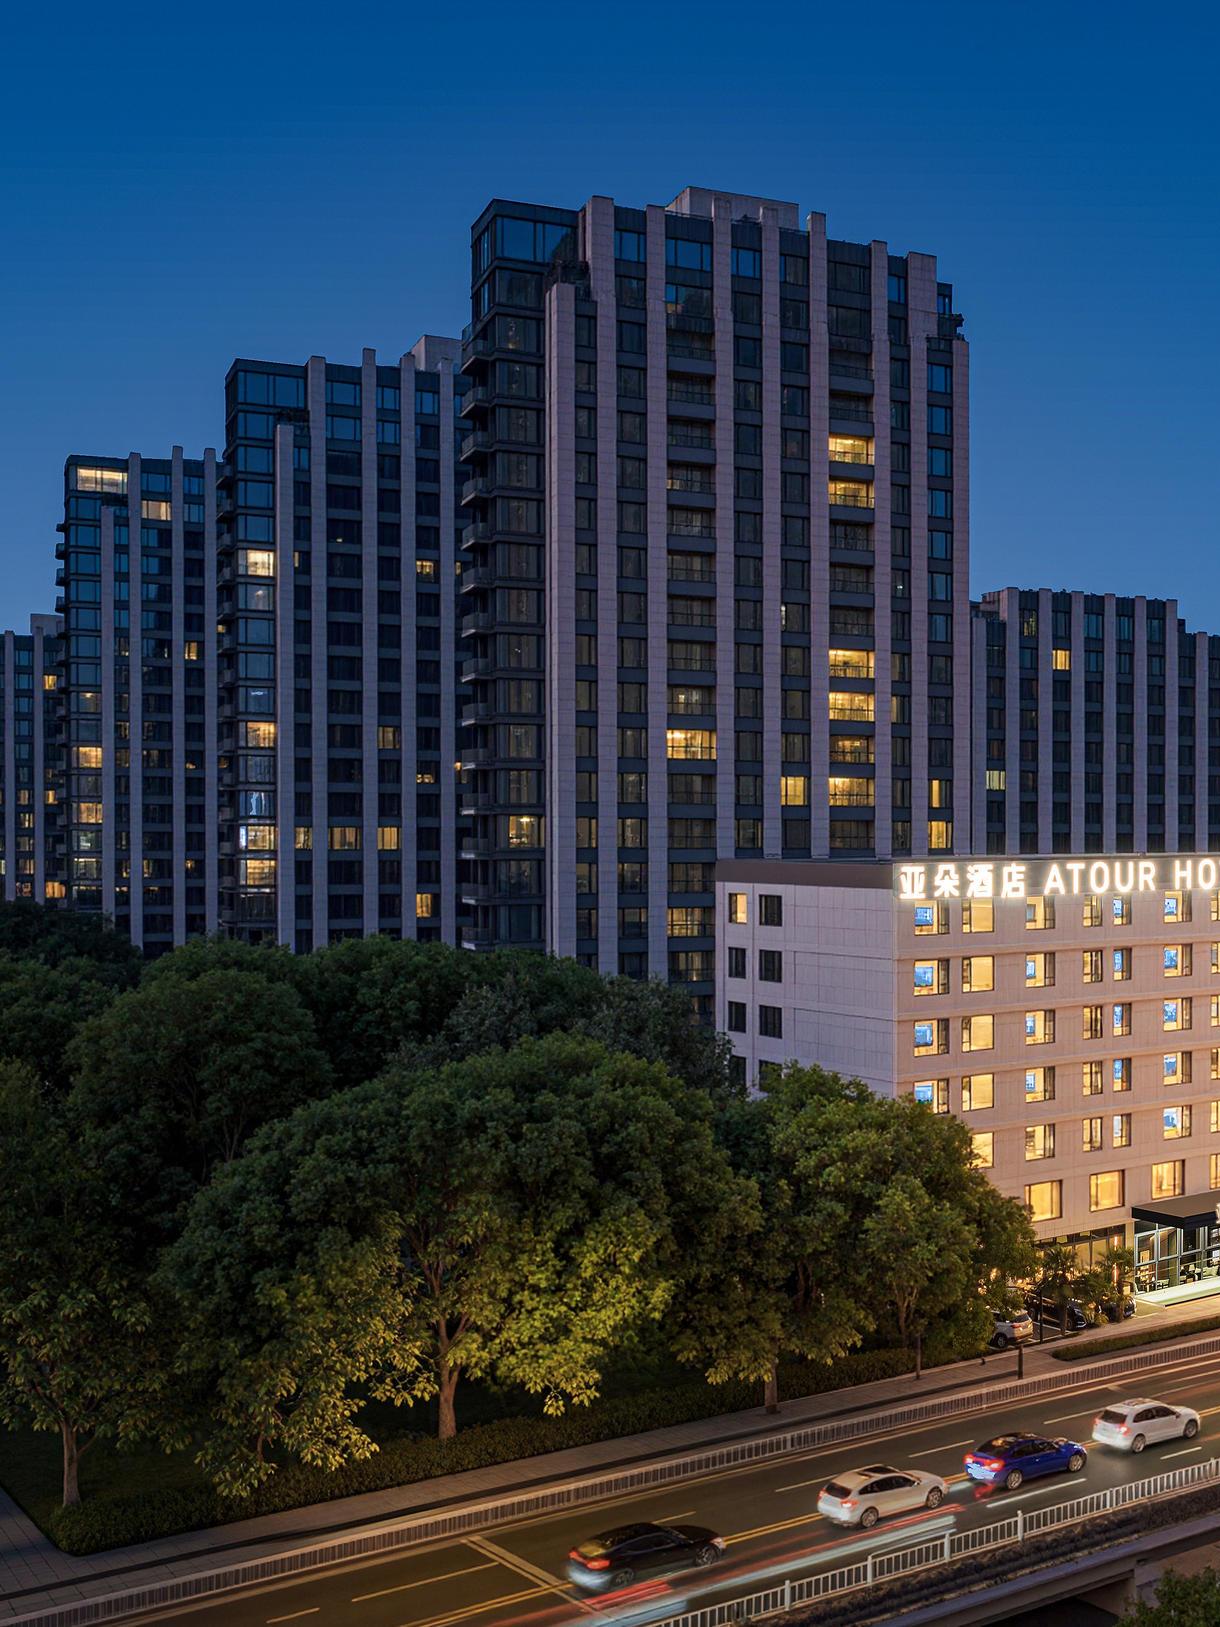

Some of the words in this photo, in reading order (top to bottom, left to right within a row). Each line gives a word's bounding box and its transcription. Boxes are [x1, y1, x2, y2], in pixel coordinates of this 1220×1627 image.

[899, 863, 1026, 900] 亚朵酒店
[1043, 860, 1156, 895] ATOUR
